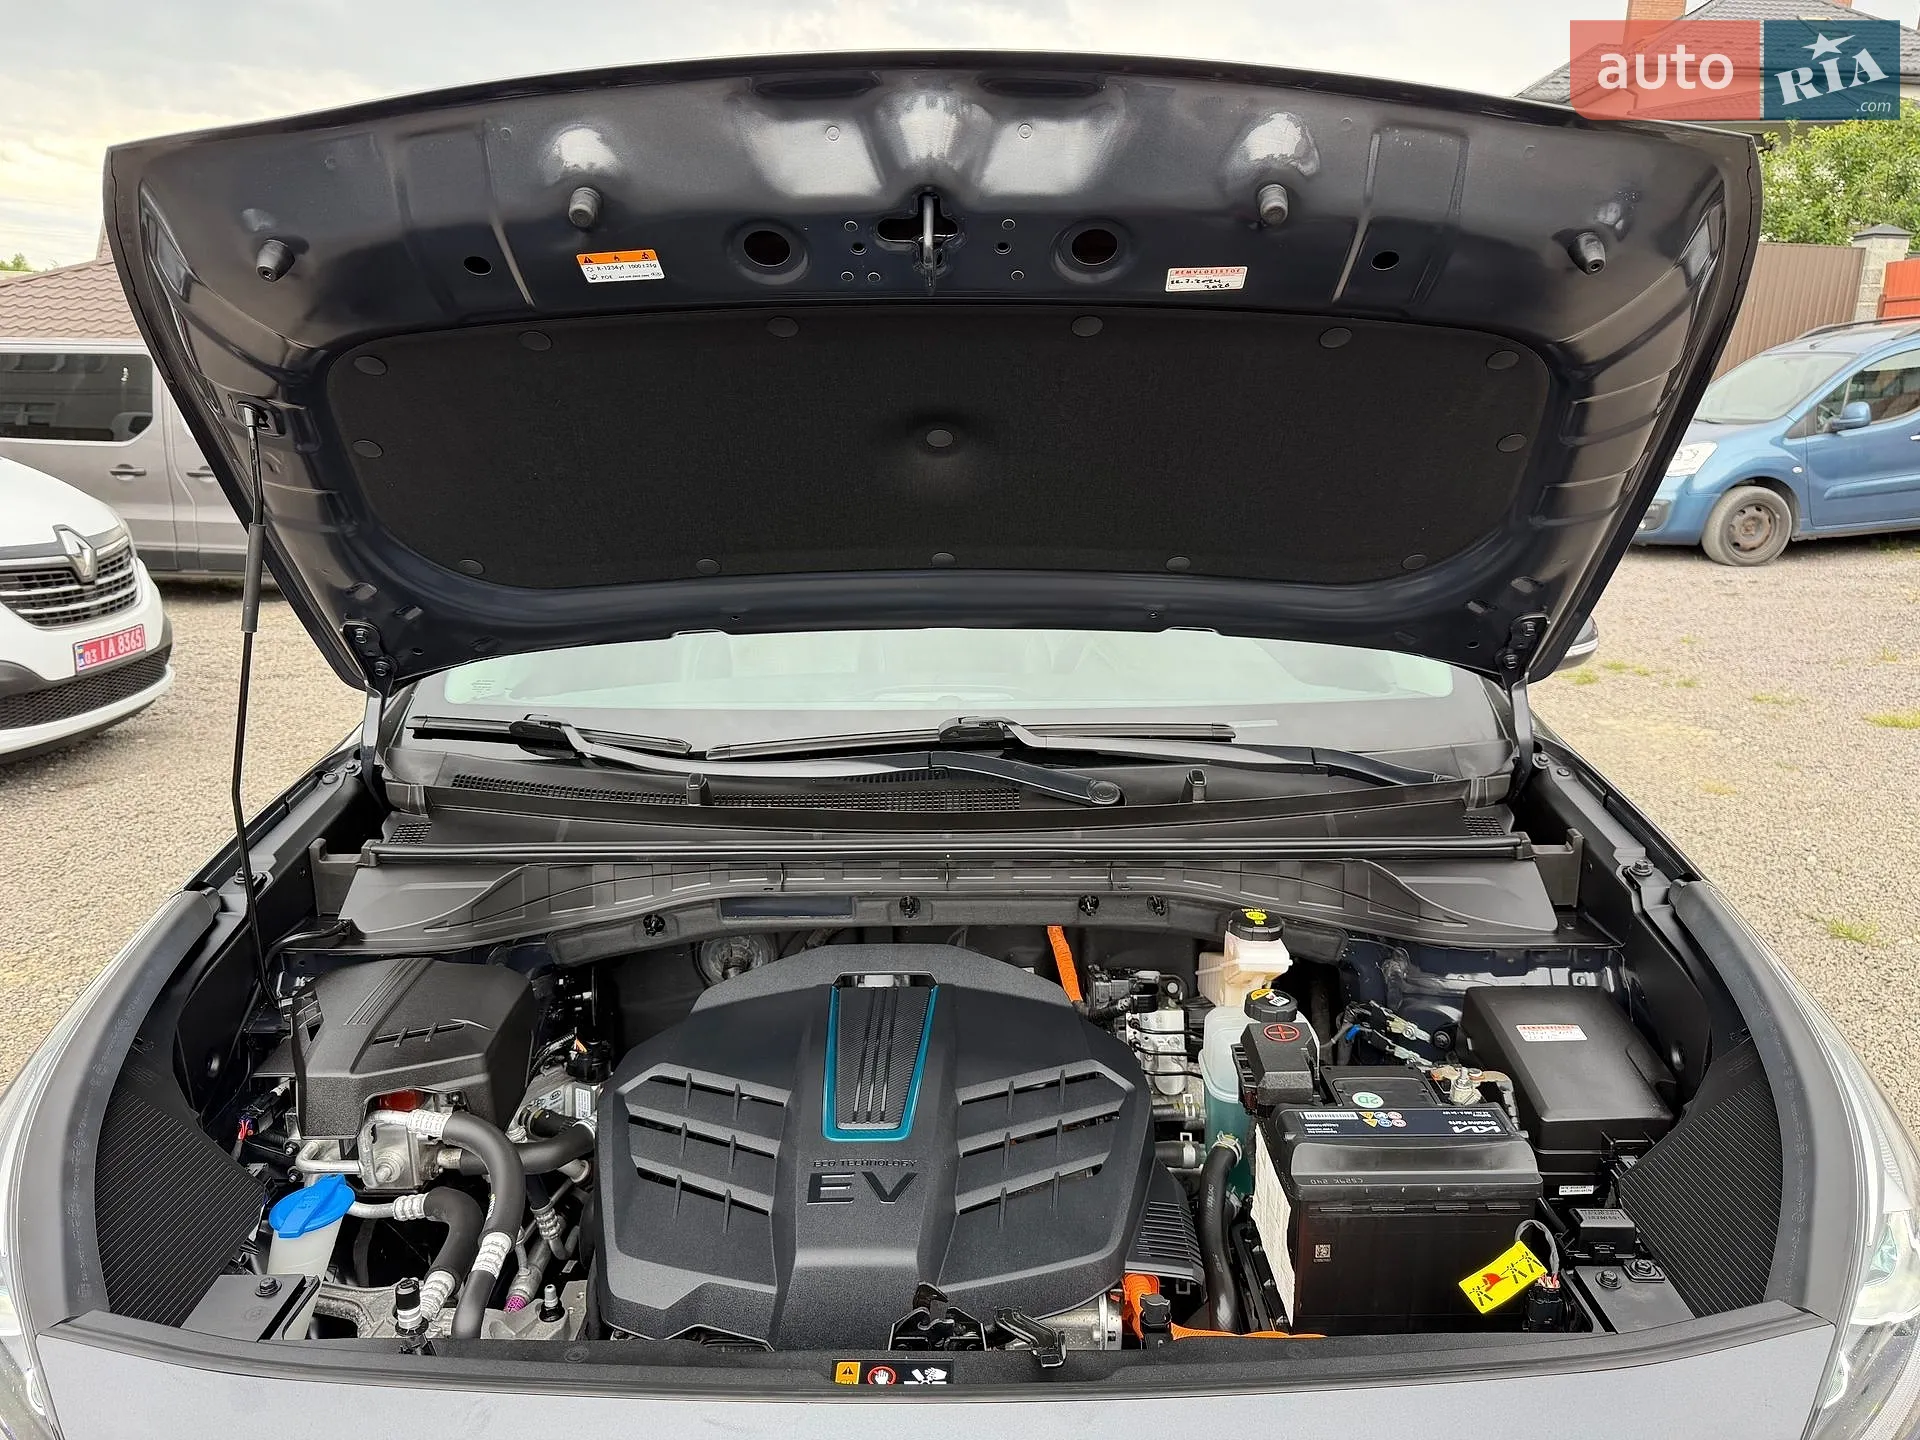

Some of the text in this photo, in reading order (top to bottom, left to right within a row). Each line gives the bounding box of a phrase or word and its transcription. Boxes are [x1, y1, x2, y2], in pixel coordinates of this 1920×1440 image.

[84, 629, 142, 664] 03 IA 8365
[840, 1158, 918, 1166] TECHNOLOGY
[806, 1171, 919, 1206] EV
